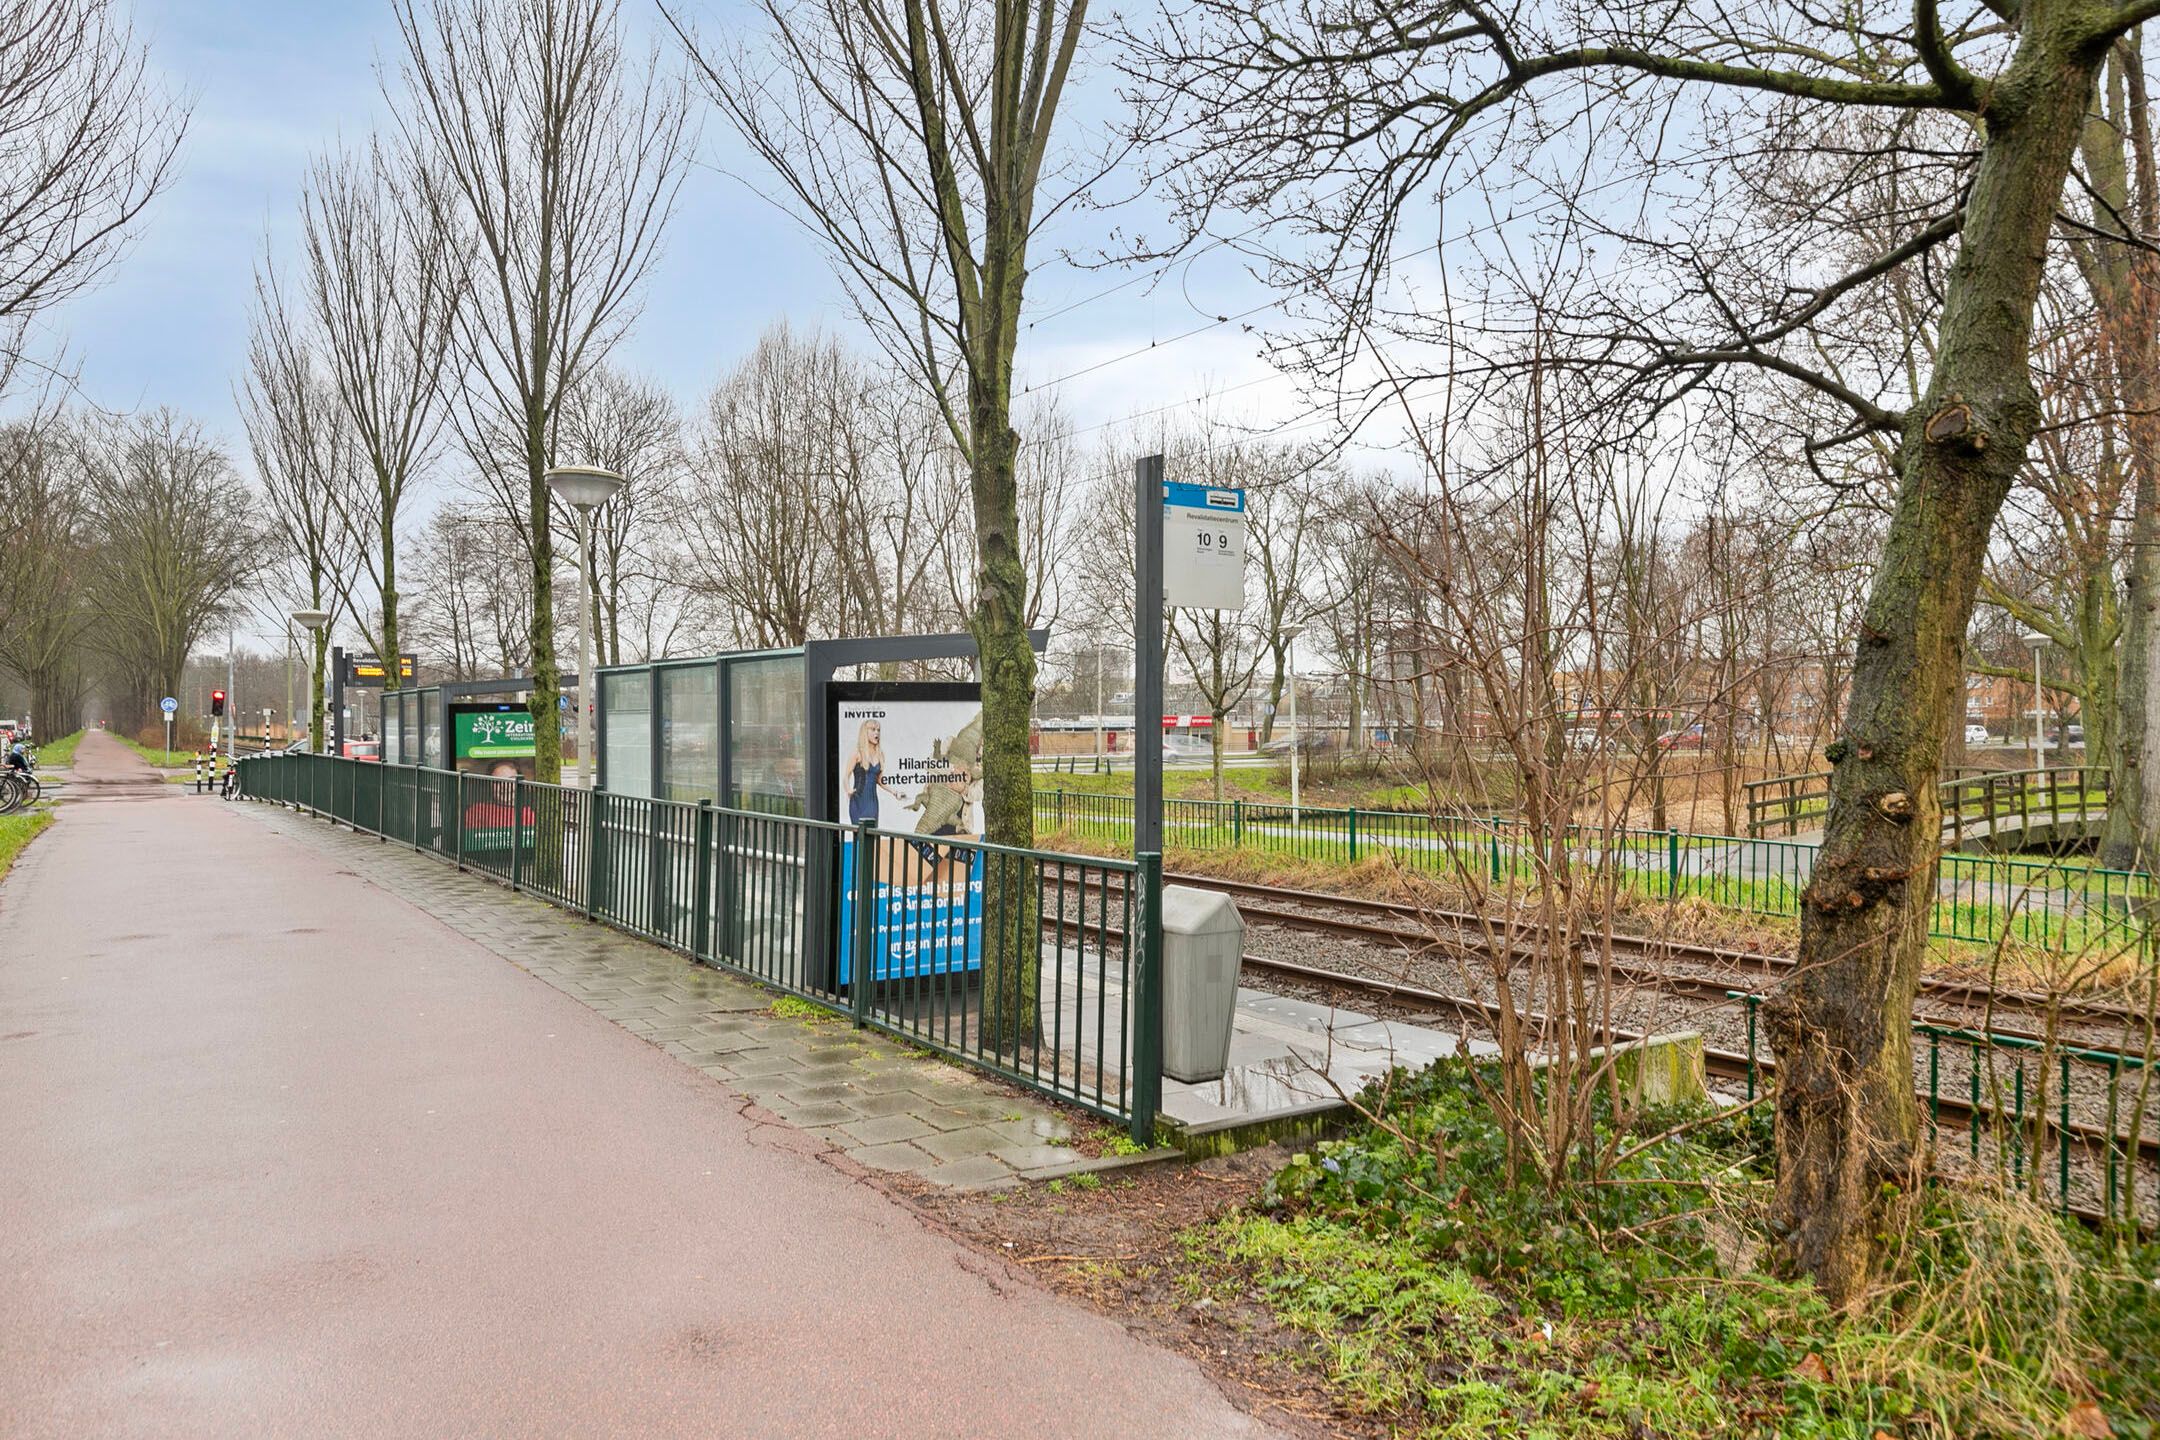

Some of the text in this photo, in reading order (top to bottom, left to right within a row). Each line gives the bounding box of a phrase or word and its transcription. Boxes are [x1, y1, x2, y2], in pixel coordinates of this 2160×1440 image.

[1197, 532, 1227, 548] 10 9
[844, 711, 886, 719] INVITED
[899, 757, 950, 770] Hilarisch
[881, 771, 967, 785] entertainment
